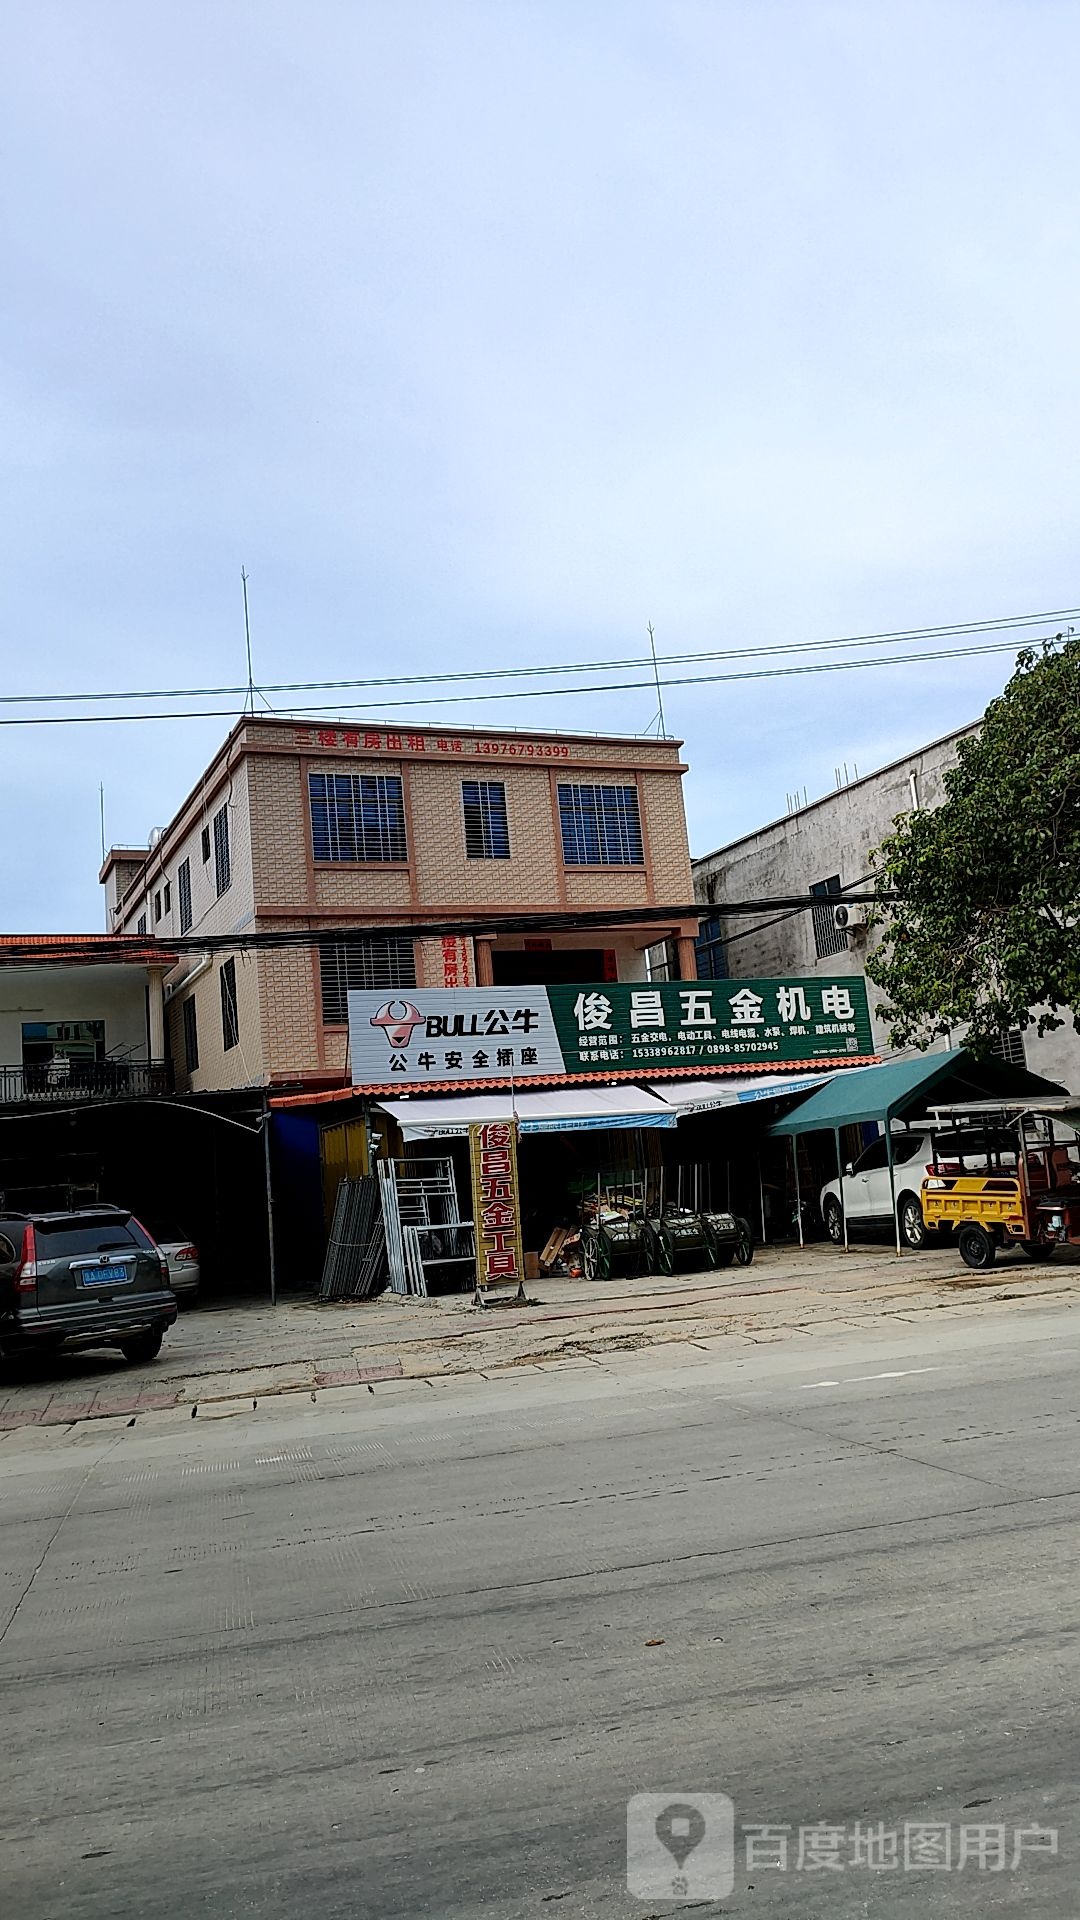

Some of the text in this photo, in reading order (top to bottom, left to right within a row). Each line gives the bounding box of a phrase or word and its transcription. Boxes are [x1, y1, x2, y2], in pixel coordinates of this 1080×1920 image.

[294, 727, 568, 757] 三楼有房出租 电话 13976793399
[573, 985, 855, 1031] 俊昌五金机电
[389, 1047, 539, 1072] 公牛安全插座
[632, 1045, 696, 1058] 15338962817
[707, 1042, 779, 1054] 0898-85702945
[479, 1122, 519, 1281] 俊昌五金工具
